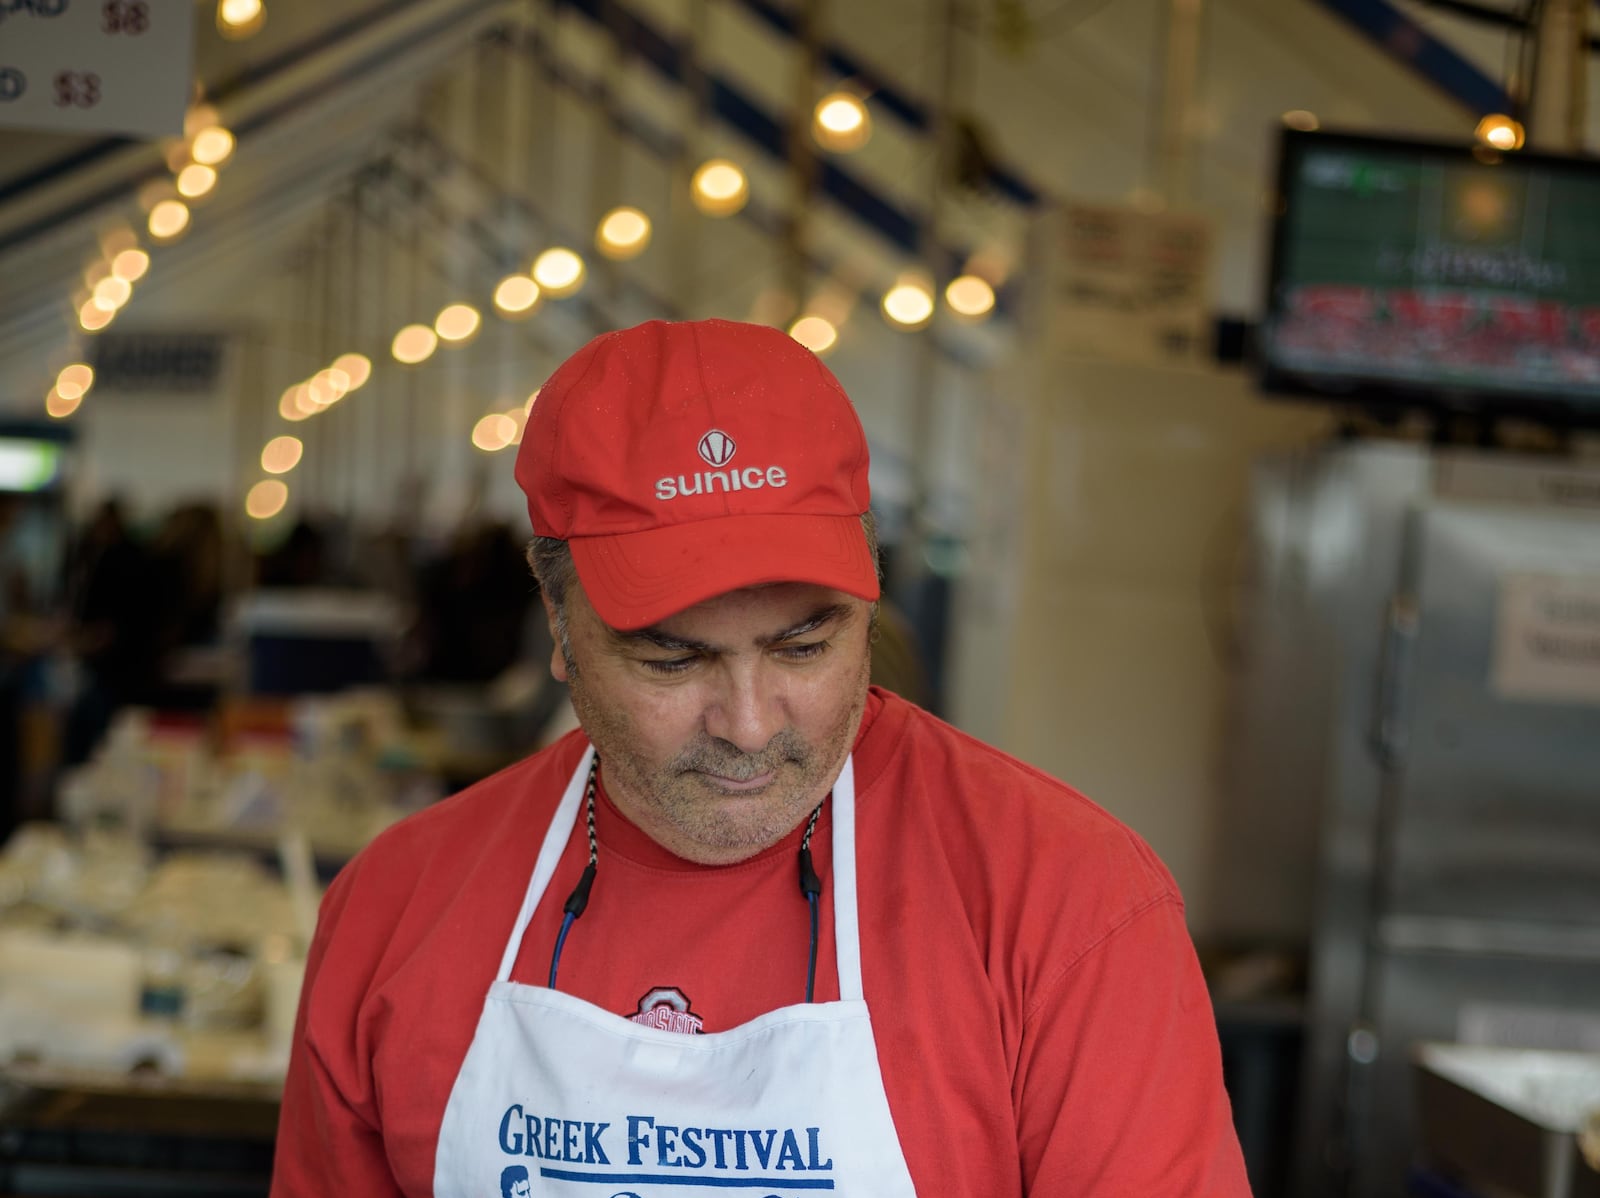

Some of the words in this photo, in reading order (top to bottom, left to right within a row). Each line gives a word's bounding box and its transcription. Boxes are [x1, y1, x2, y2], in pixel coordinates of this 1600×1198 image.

[655, 465, 788, 501] sunice
[499, 1103, 611, 1166] GREEK
[626, 1115, 834, 1171] FESTIVAL
